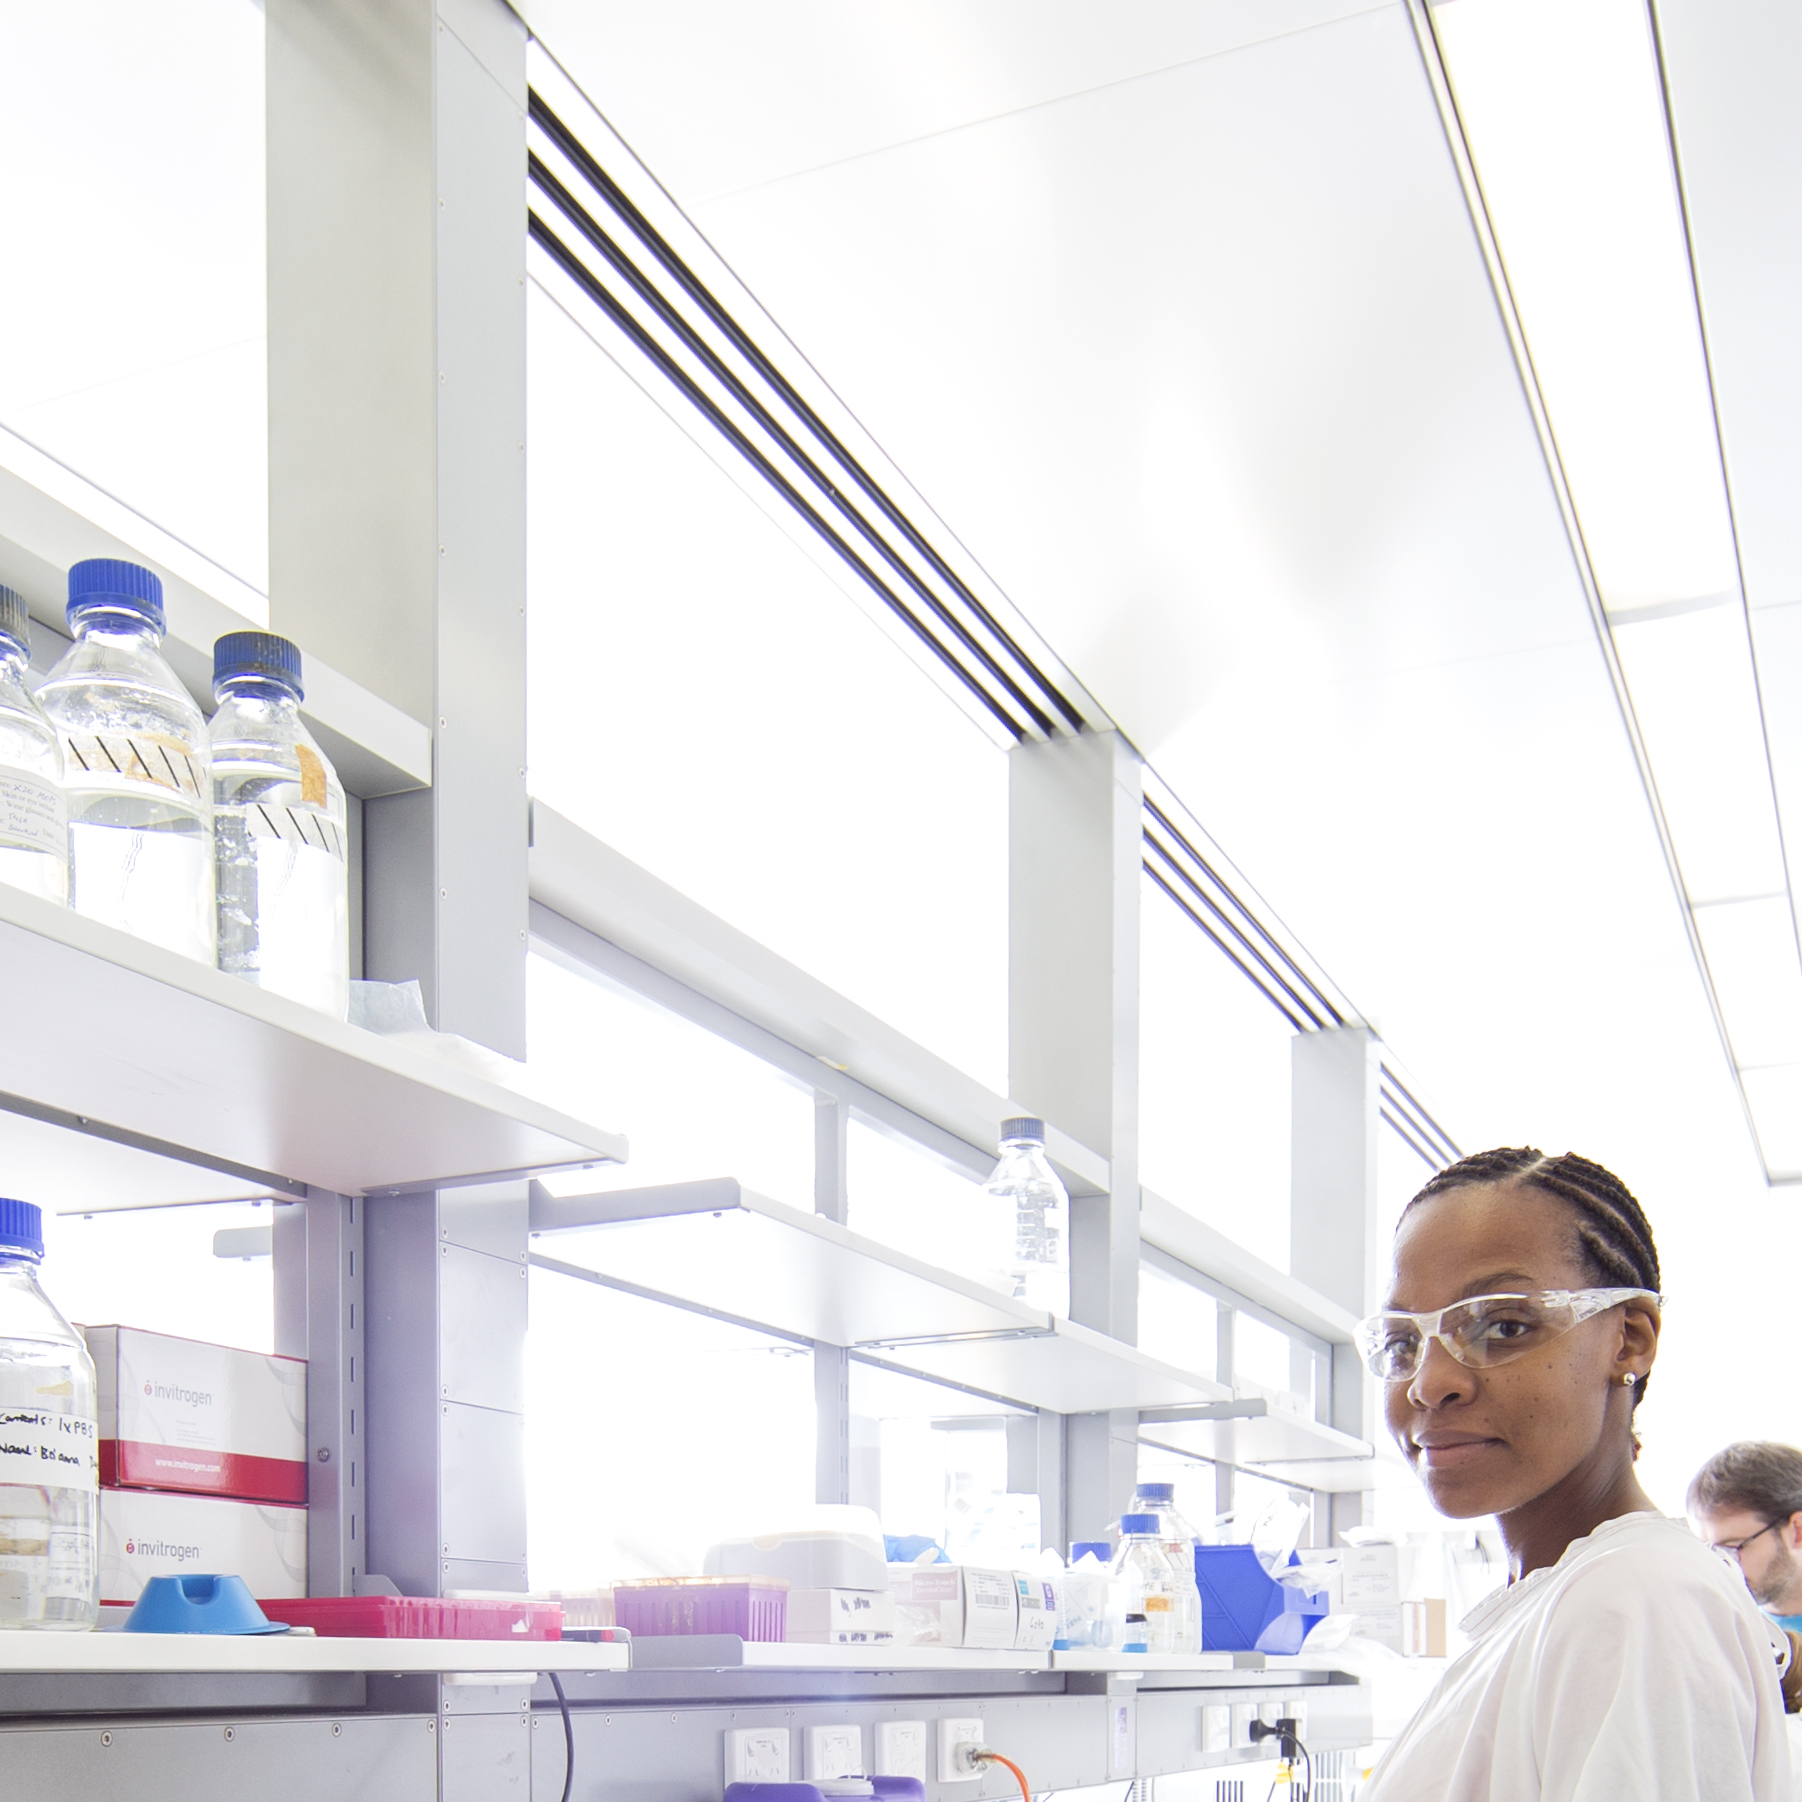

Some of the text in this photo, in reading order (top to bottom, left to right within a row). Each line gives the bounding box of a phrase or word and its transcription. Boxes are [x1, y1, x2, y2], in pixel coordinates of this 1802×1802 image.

[154, 1382, 212, 1408] invitrogen
[154, 1457, 221, 1474] www.invitrogen.com
[137, 1539, 200, 1562] invitrogen
